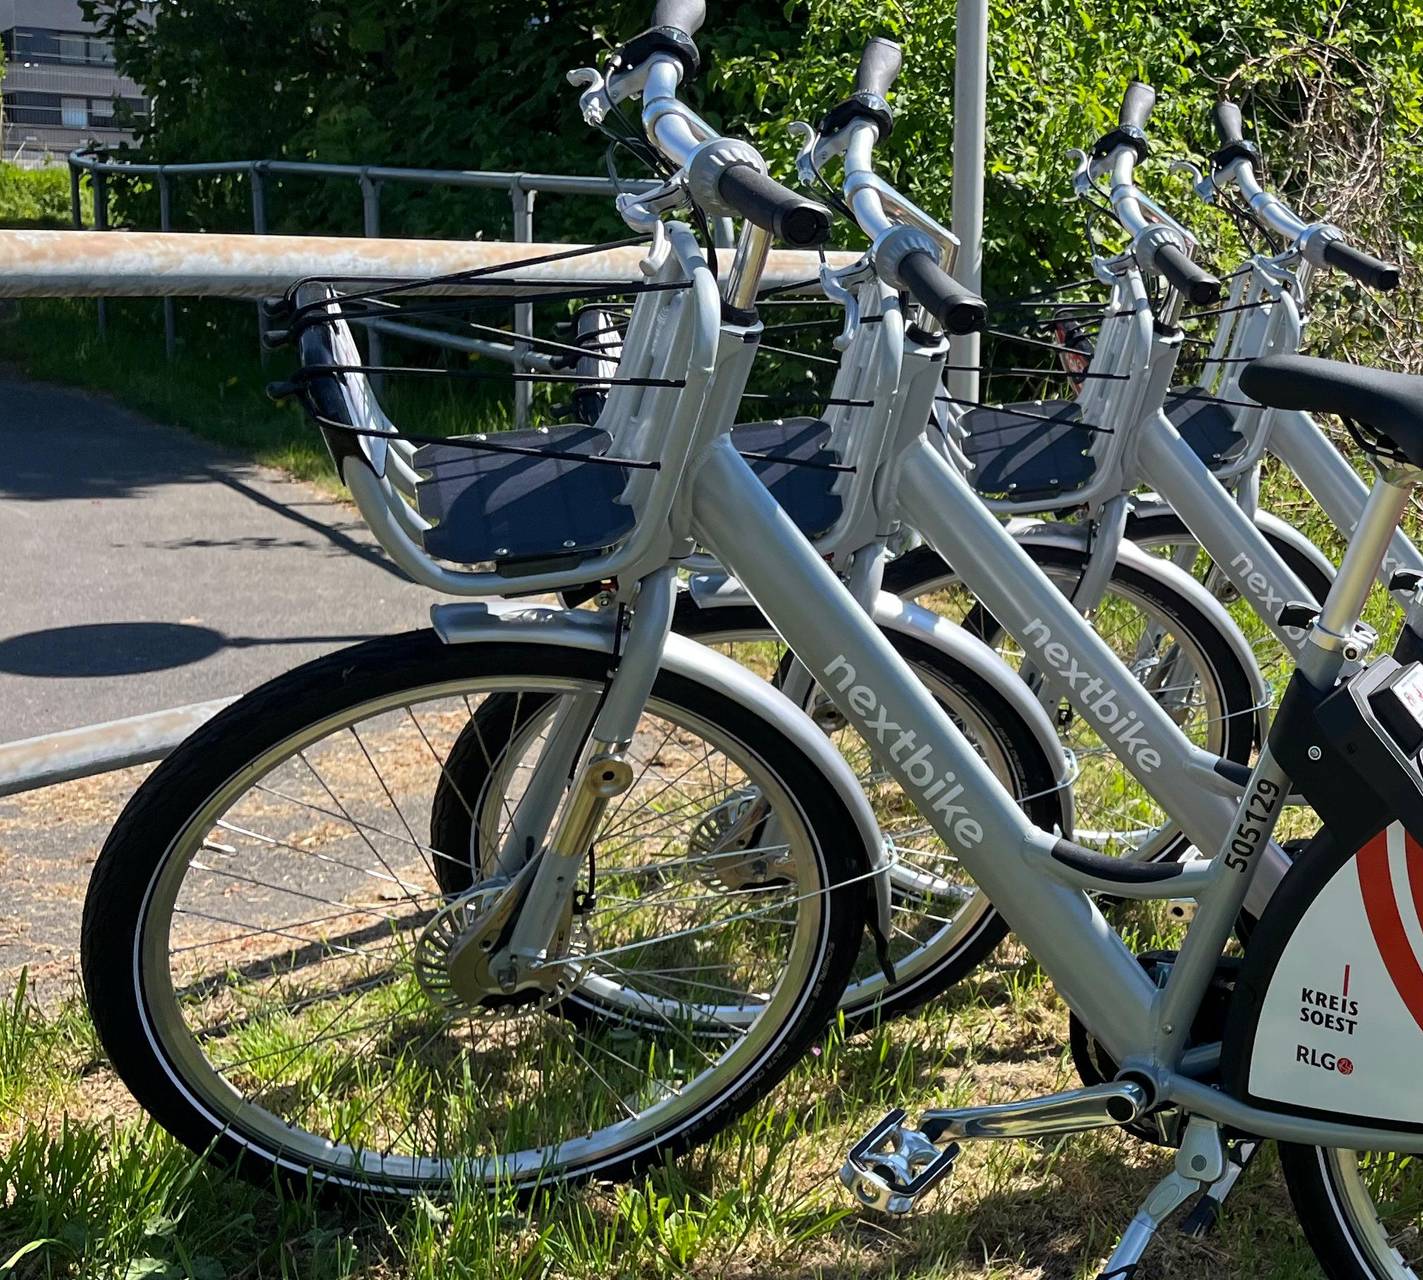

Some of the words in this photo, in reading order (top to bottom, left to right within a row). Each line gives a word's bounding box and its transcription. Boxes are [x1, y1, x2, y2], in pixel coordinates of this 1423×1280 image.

[1022, 618, 1161, 772] nextbike
[824, 654, 984, 849] nextbike
[1225, 779, 1280, 873] 505129
[1299, 1007, 1358, 1035] SOEST
[1301, 987, 1359, 1016] KREIS
[1296, 1044, 1336, 1071] RLG
